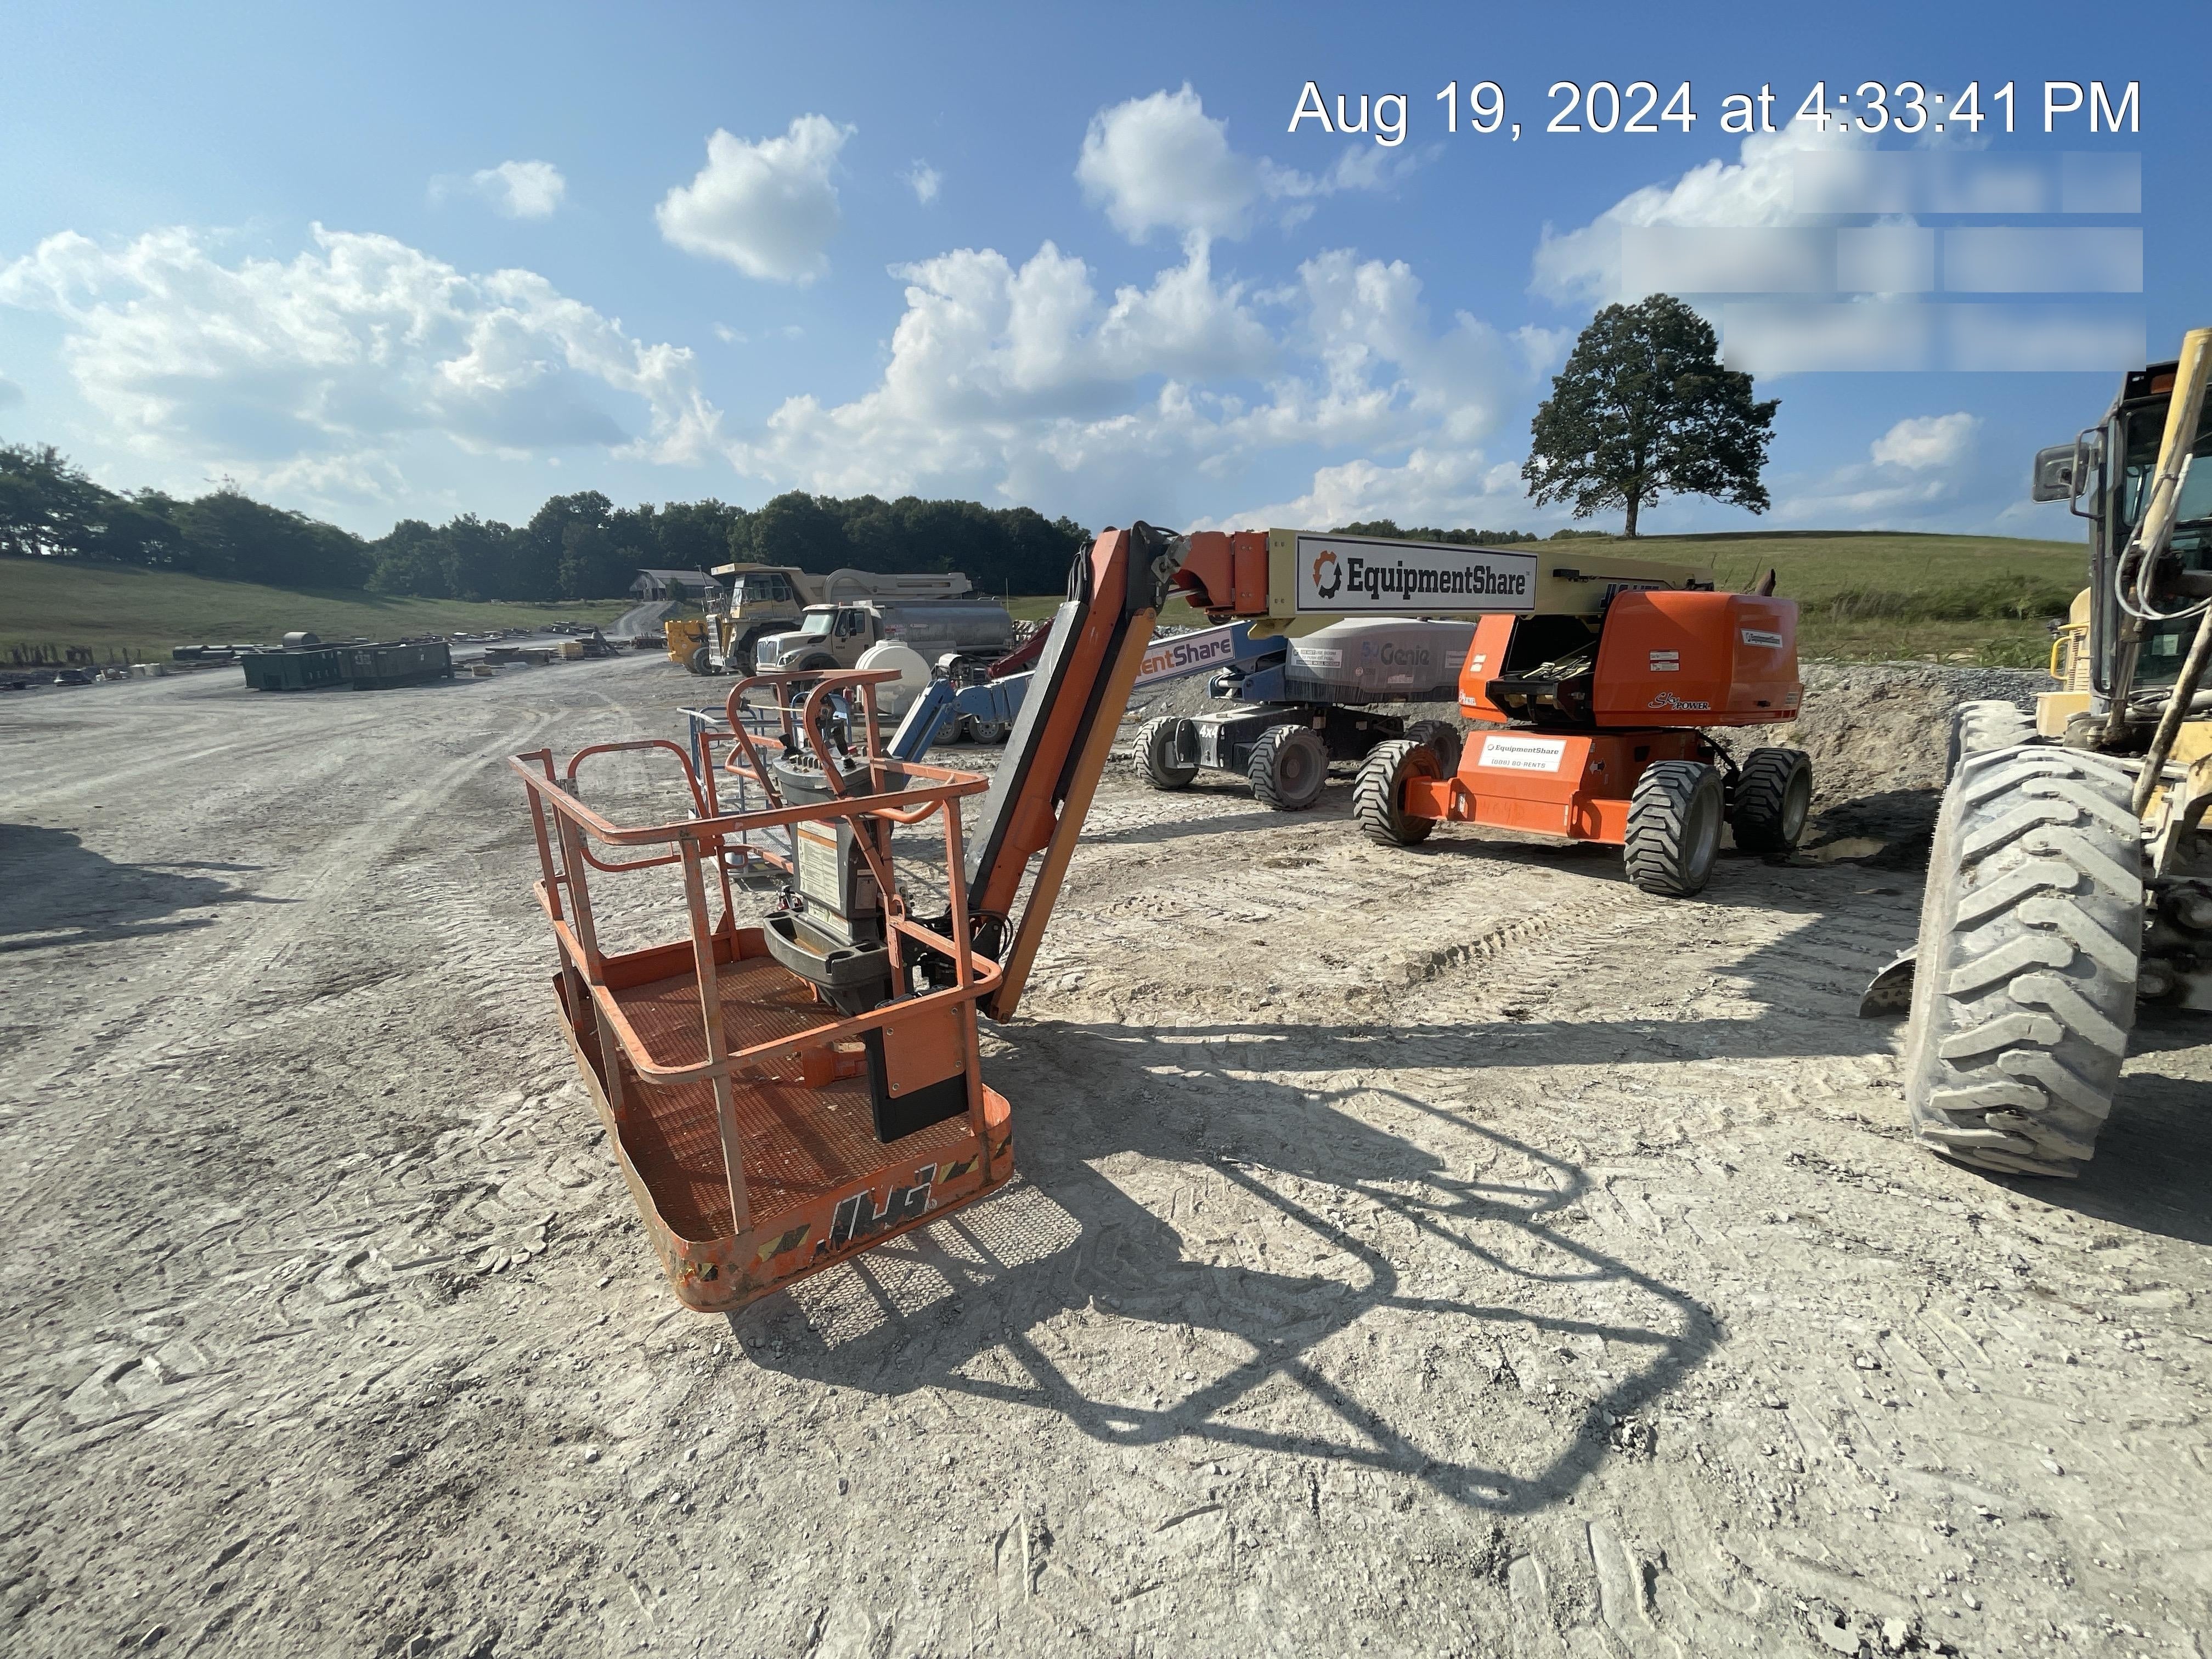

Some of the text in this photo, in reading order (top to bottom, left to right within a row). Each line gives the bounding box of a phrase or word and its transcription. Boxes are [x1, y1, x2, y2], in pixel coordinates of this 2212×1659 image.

[1347, 557, 1525, 600] EquipmentShare
[1141, 639, 1231, 675] entShare
[1676, 702, 1708, 710] POWER
[1199, 724, 1219, 738] 4x4
[1495, 744, 1559, 755] EquipmentShare
